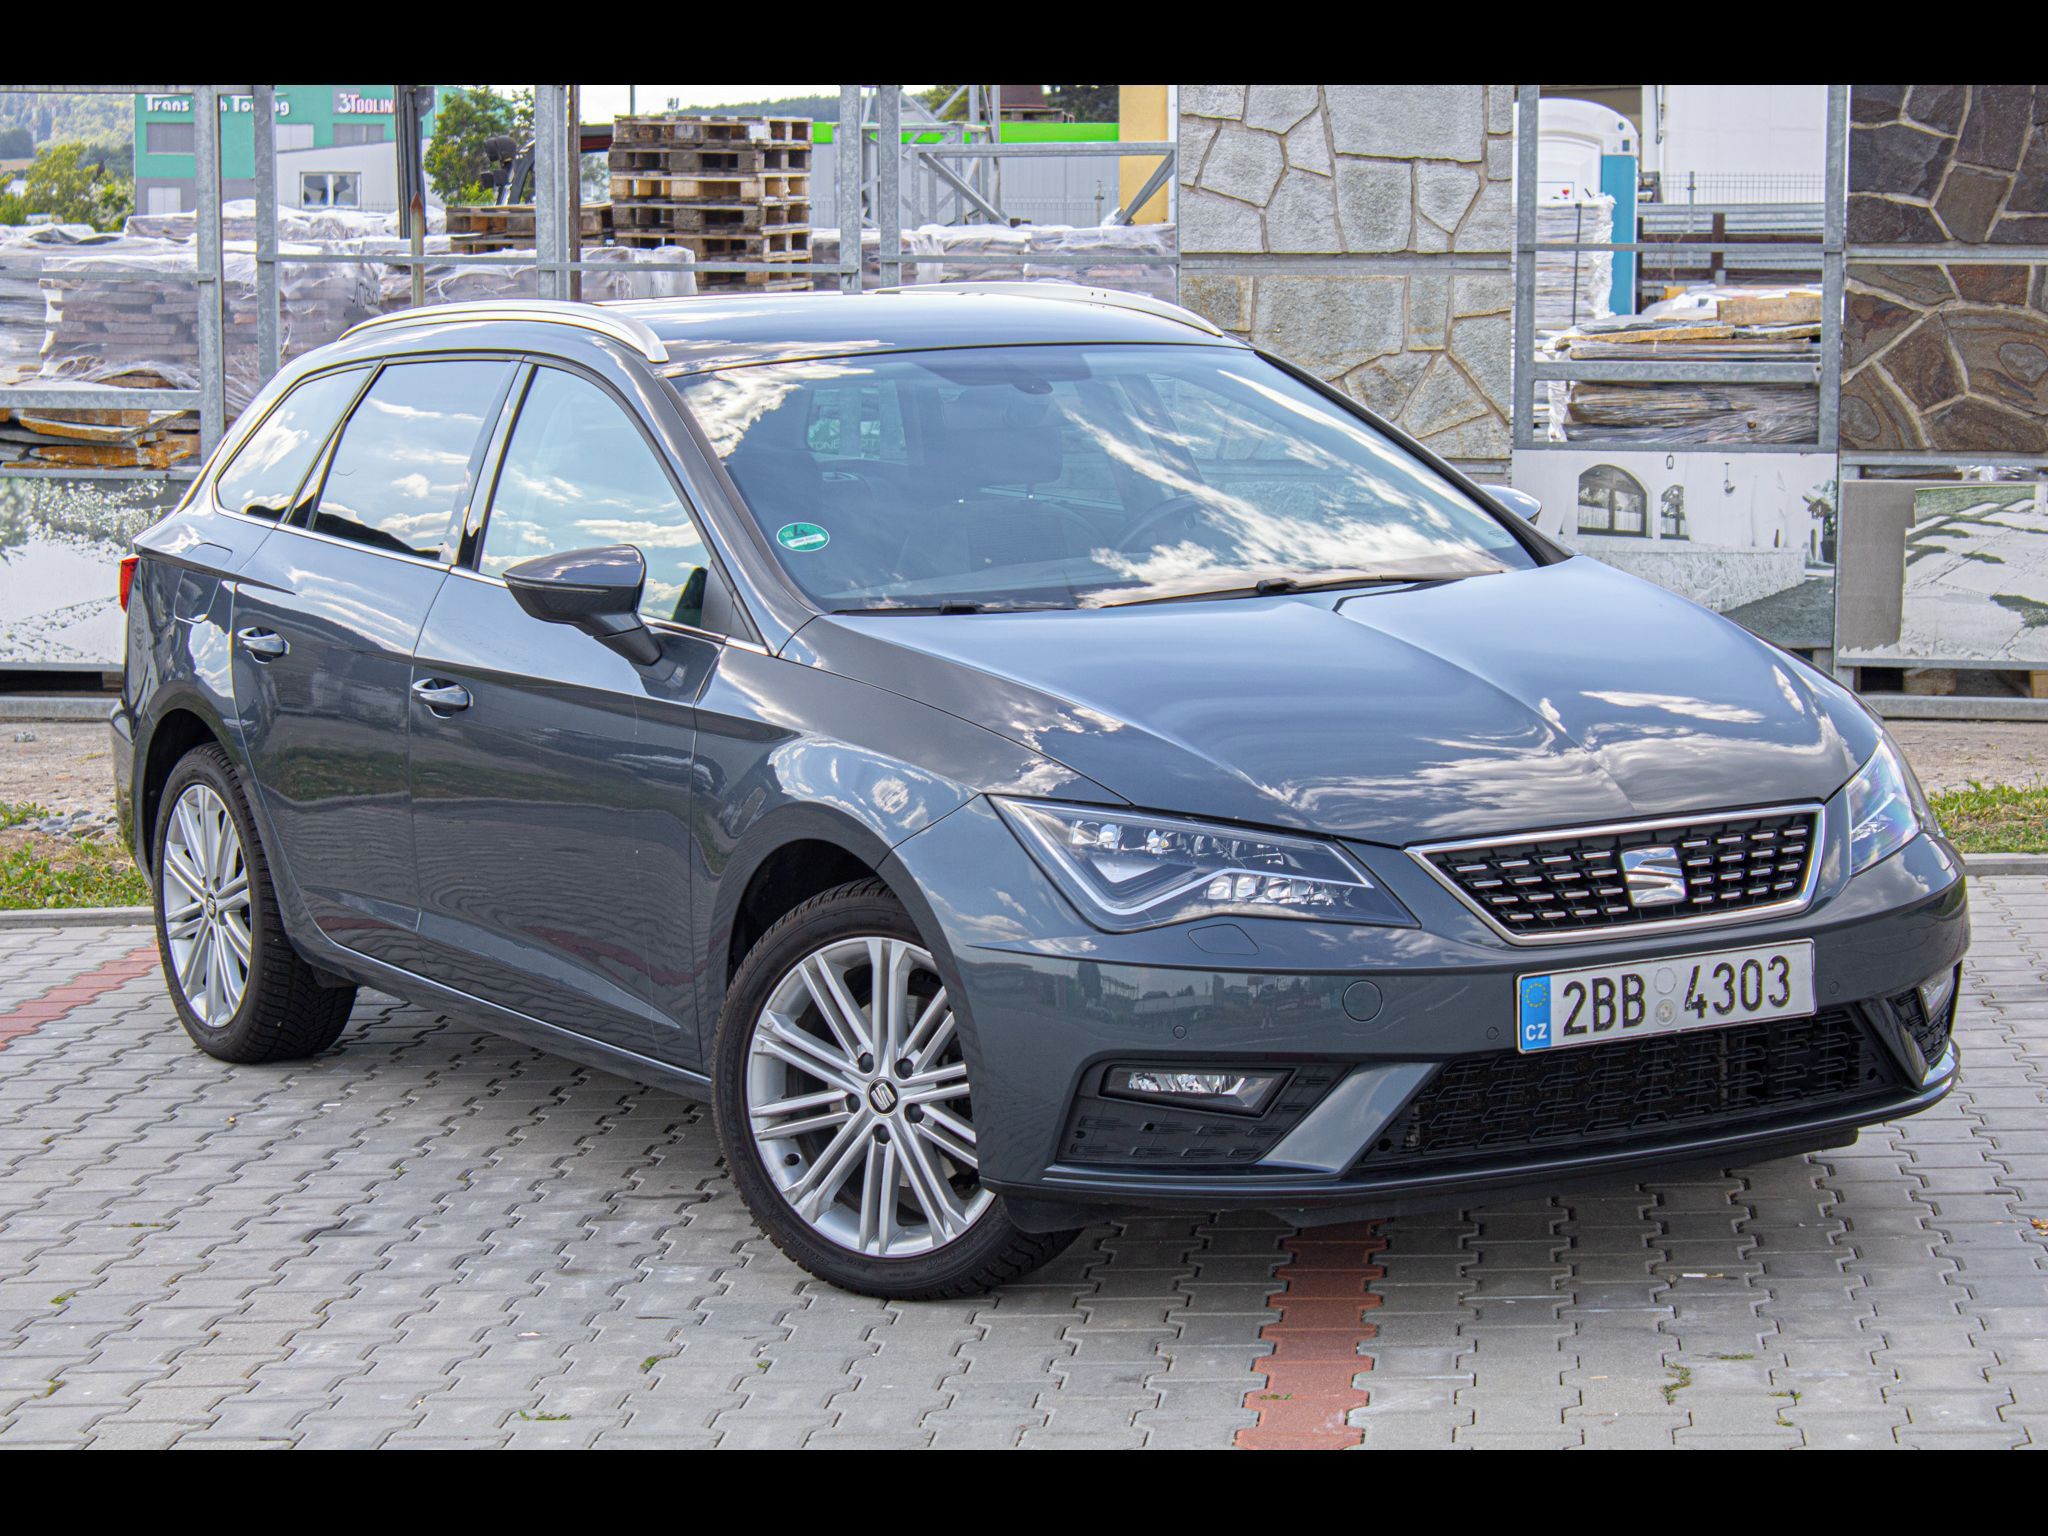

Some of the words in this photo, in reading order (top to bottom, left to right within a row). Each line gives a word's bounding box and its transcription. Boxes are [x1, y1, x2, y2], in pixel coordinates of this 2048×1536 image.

[144, 93, 190, 112] Trans
[338, 93, 394, 113] 3TOOLIN
[1562, 973, 1646, 1036] 2BB
[1684, 955, 1790, 1019] 4303
[1525, 1022, 1548, 1041] CZ
